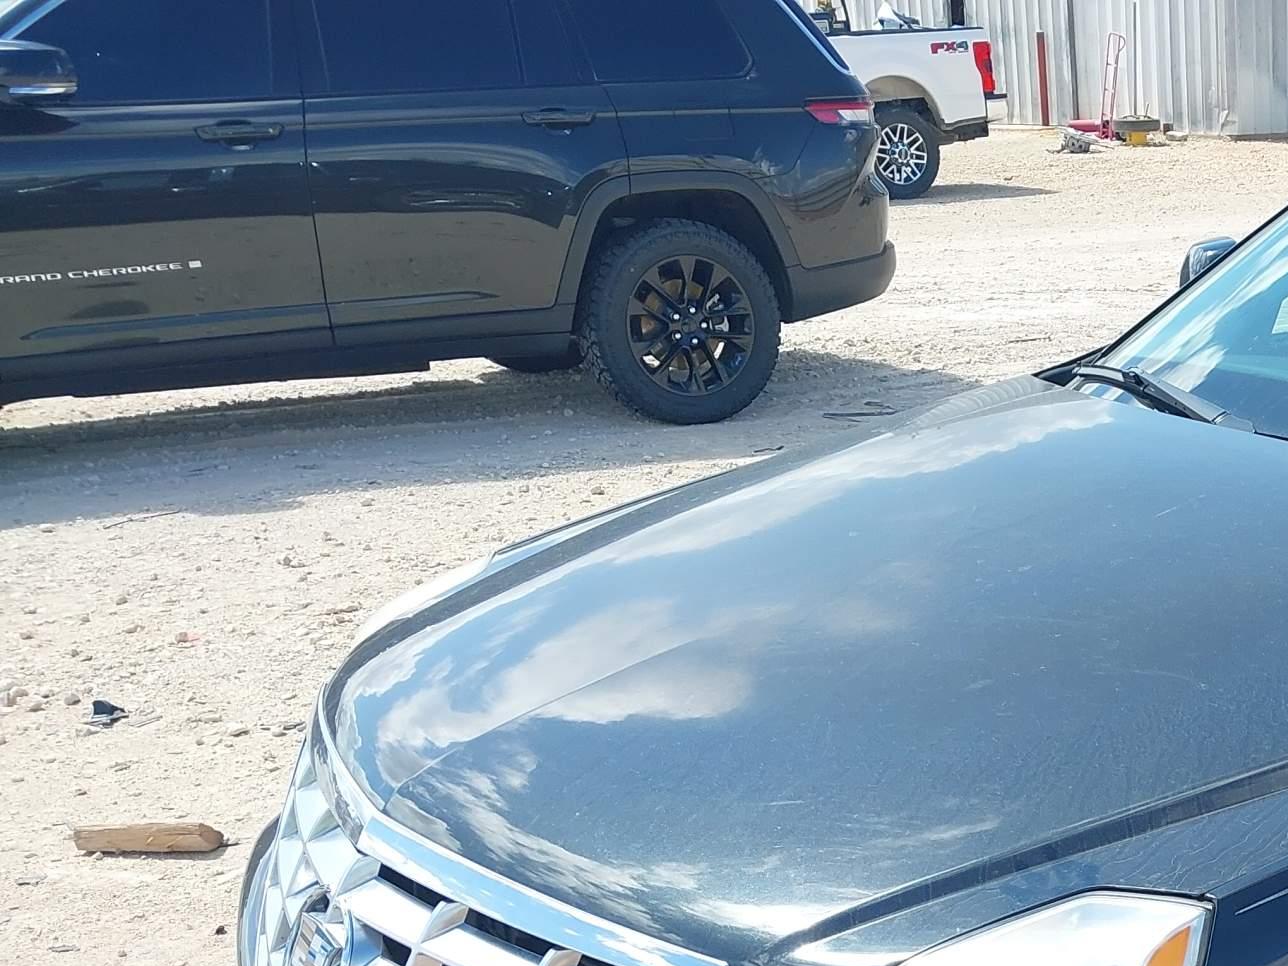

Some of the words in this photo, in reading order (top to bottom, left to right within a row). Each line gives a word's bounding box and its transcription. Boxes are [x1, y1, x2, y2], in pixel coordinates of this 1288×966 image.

[930, 40, 969, 55] FX4
[0, 272, 62, 284] RAND
[67, 262, 183, 279] CHEROKEE
